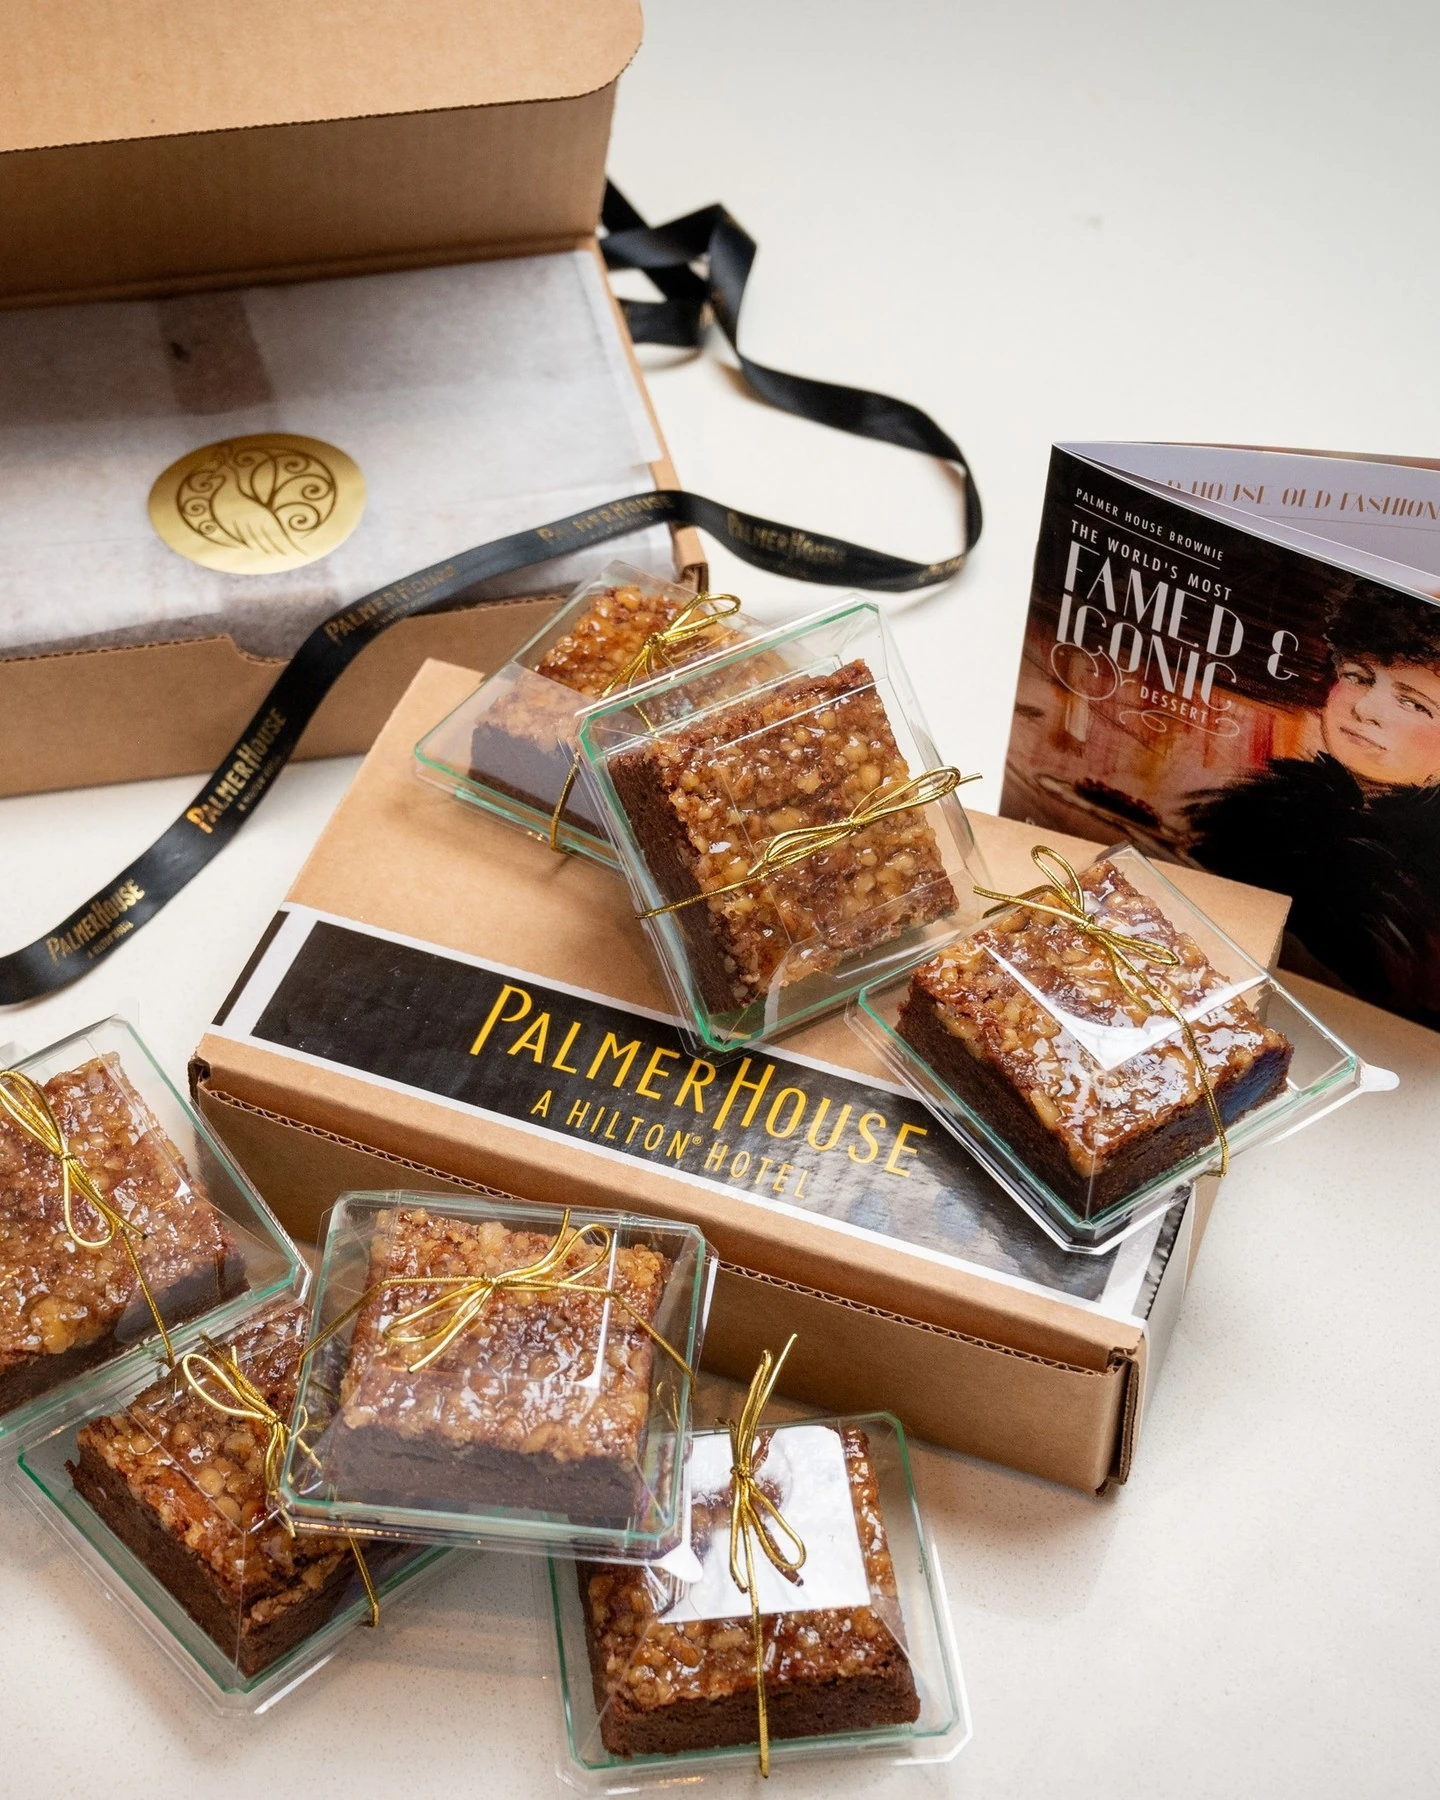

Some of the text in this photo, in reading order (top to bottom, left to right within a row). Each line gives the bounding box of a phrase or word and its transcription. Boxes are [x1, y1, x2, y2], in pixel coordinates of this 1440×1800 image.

[1076, 488, 1224, 562] PALMER HOUSE BROWNIE
[1282, 487, 1331, 509] OLD
[1071, 519, 1232, 600] THE WORLD'S MOST
[1064, 540, 1299, 680] FAMED &
[1053, 593, 1237, 711] ICONIC
[1140, 686, 1209, 723] DESSERT
[530, 1089, 552, 1118] A
[703, 1141, 808, 1199] HOTEL
